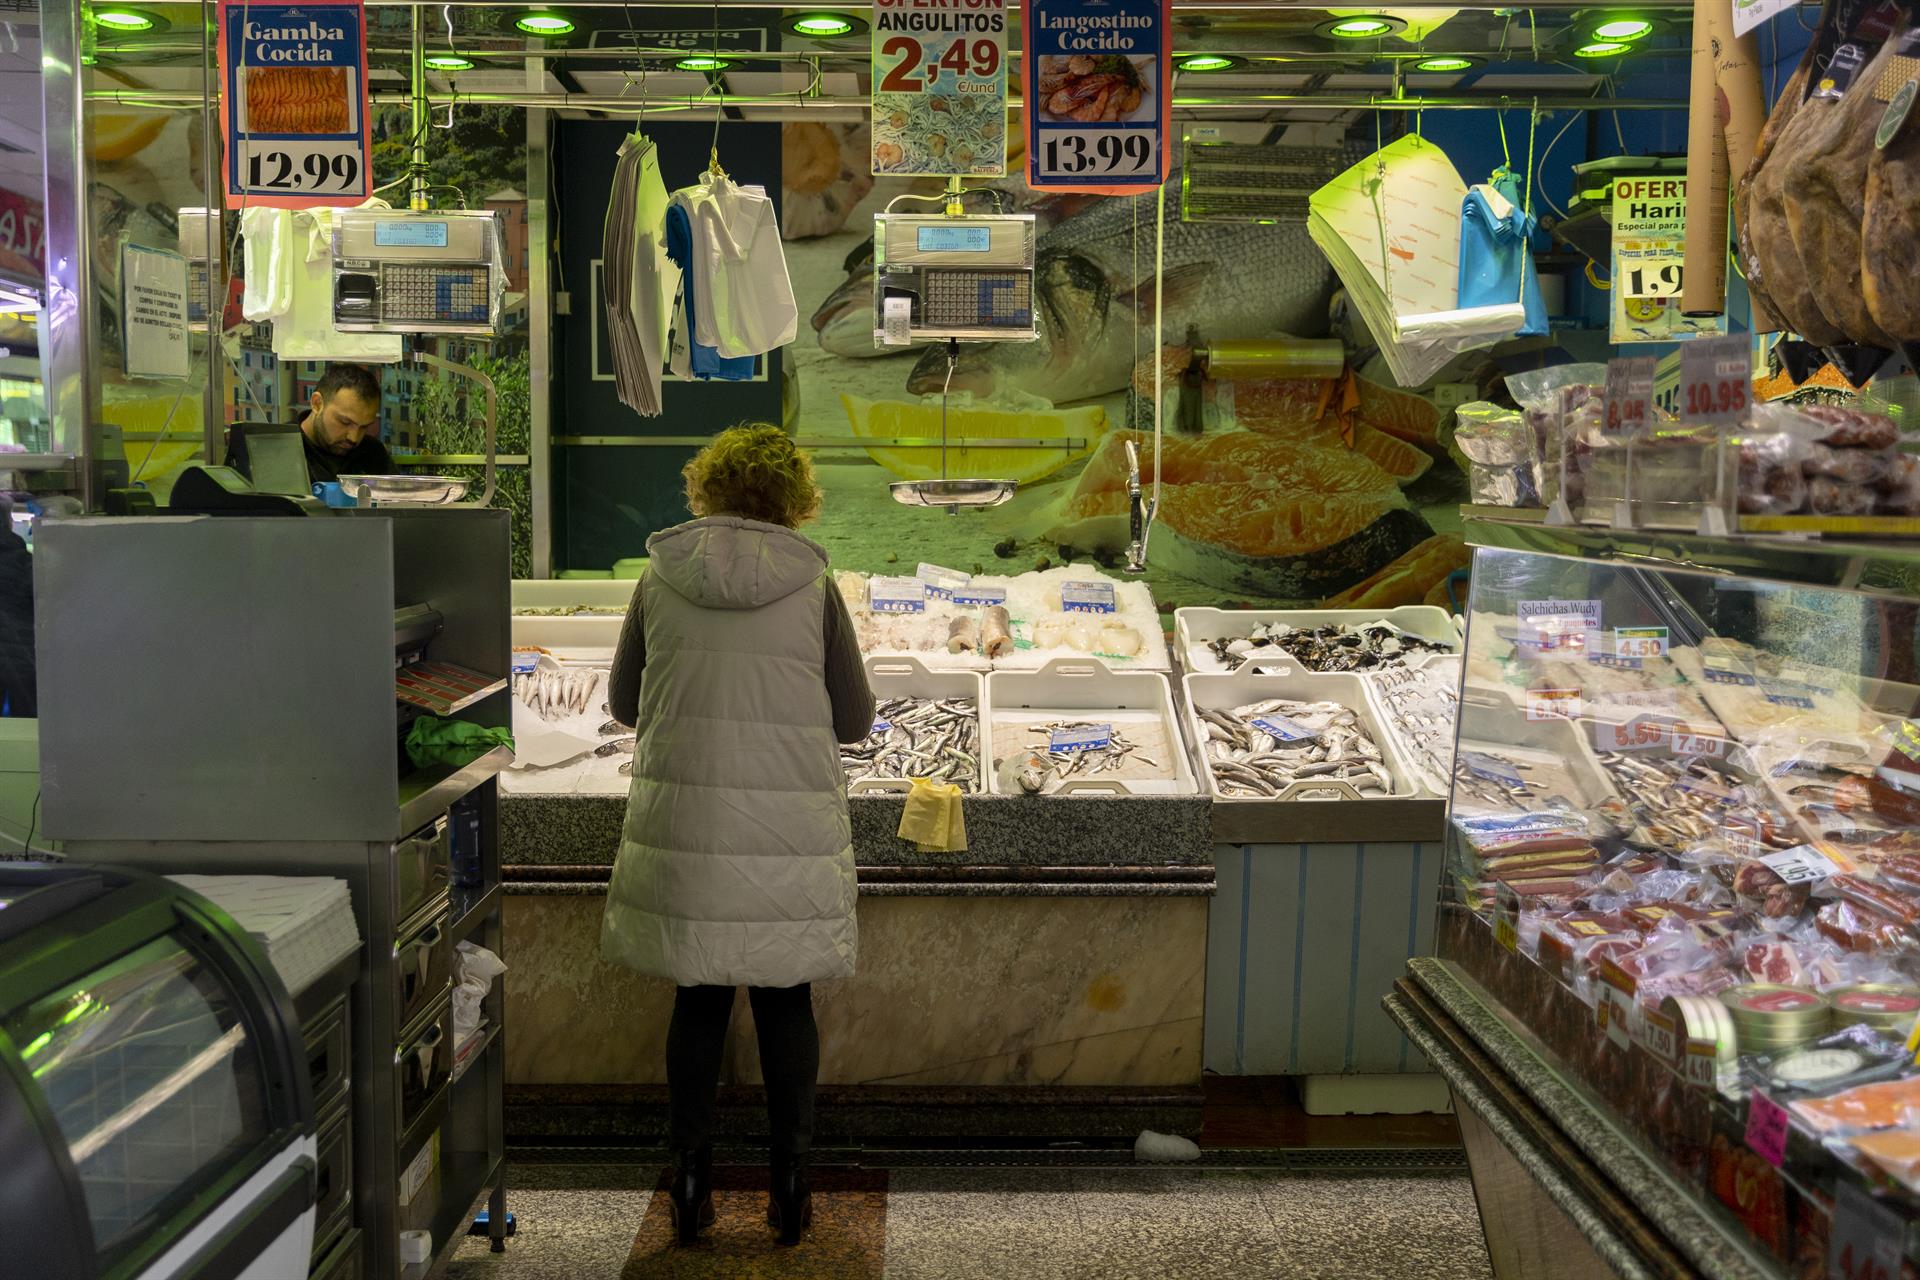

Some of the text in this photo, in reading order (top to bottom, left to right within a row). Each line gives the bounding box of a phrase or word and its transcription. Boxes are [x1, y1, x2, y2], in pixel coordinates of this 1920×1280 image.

[244, 21, 344, 41] Gamba
[877, 12, 1003, 32] ANGULITOS
[1040, 10, 1152, 34] Langostino
[1058, 30, 1135, 50] Cocido
[256, 42, 333, 62] Cocida
[880, 36, 1000, 92] 2,49
[957, 81, 996, 94] €/und
[1043, 135, 1151, 173] 13,99
[248, 152, 358, 191] 12,99
[1616, 180, 1687, 200] OFERT
[1630, 202, 1686, 219] Hari
[1618, 222, 1656, 232] Especial
[1658, 223, 1679, 231] para
[1626, 265, 1684, 295] 1,9
[1687, 379, 1746, 416] 10.95
[1521, 602, 1597, 616] Salchichas Wudy
[1619, 640, 1661, 656] 4.50
[1614, 722, 1662, 745] 5.50
[1678, 735, 1717, 753] 7.50
[1648, 1024, 1671, 1054] 7.50
[1689, 1057, 1712, 1082] 4.10
